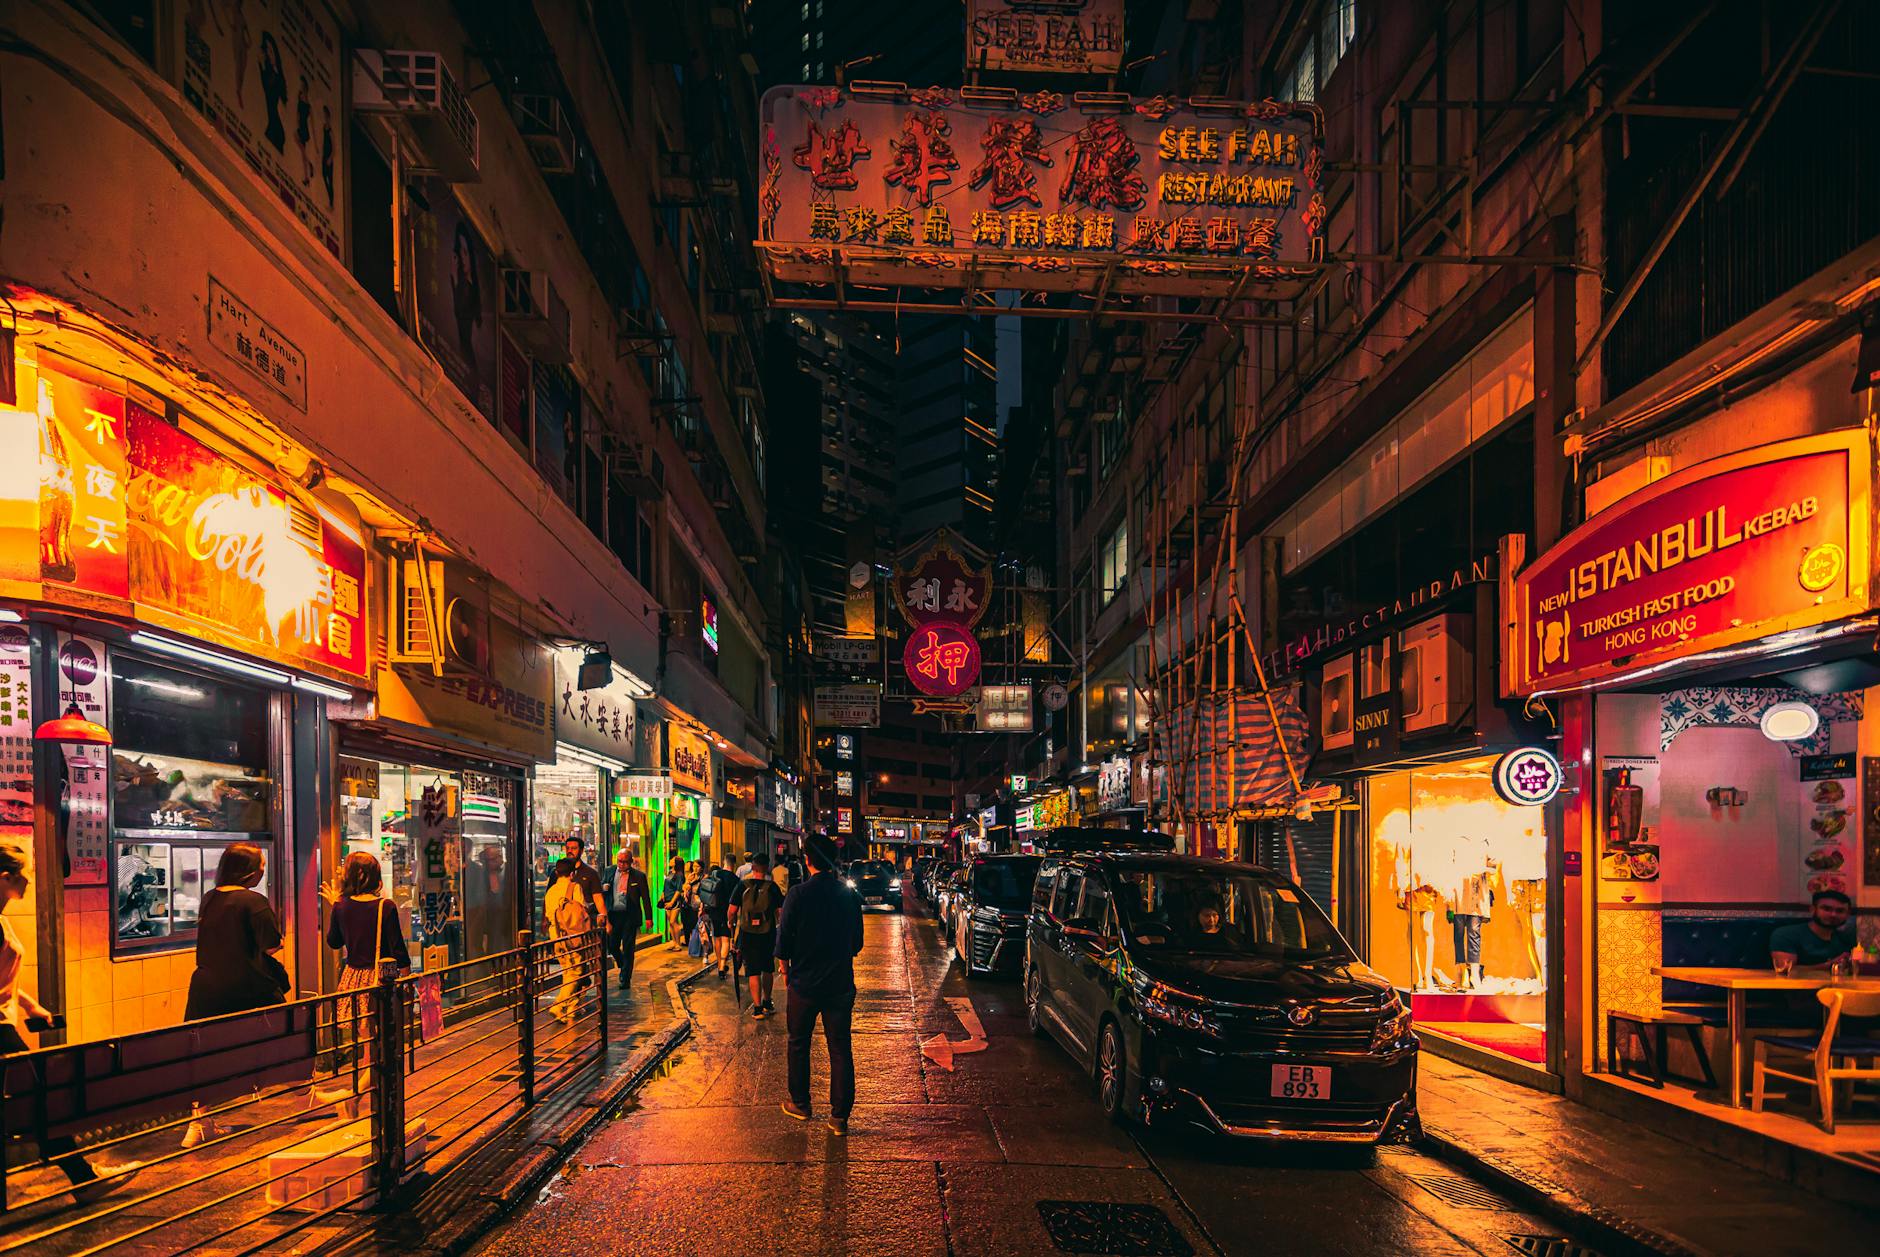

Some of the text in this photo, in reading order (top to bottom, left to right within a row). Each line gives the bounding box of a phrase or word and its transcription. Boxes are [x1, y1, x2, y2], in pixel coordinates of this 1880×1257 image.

[1158, 126, 1297, 165] SEE FAH
[1158, 172, 1296, 206] RESTAURANT
[221, 295, 298, 367] Hart Avenue
[235, 331, 287, 387] 赫德道
[84, 407, 119, 555] 不夜天
[1539, 496, 1819, 615] NEW ISTANBUL KEBAB
[1581, 575, 1736, 638] TURKISH FAST FOOD
[1605, 614, 1697, 651] HONG KONG
[916, 631, 970, 685] 押
[1356, 709, 1389, 731] SINNY
[1283, 1082, 1319, 1098] 893
[1289, 1067, 1314, 1083] EB
